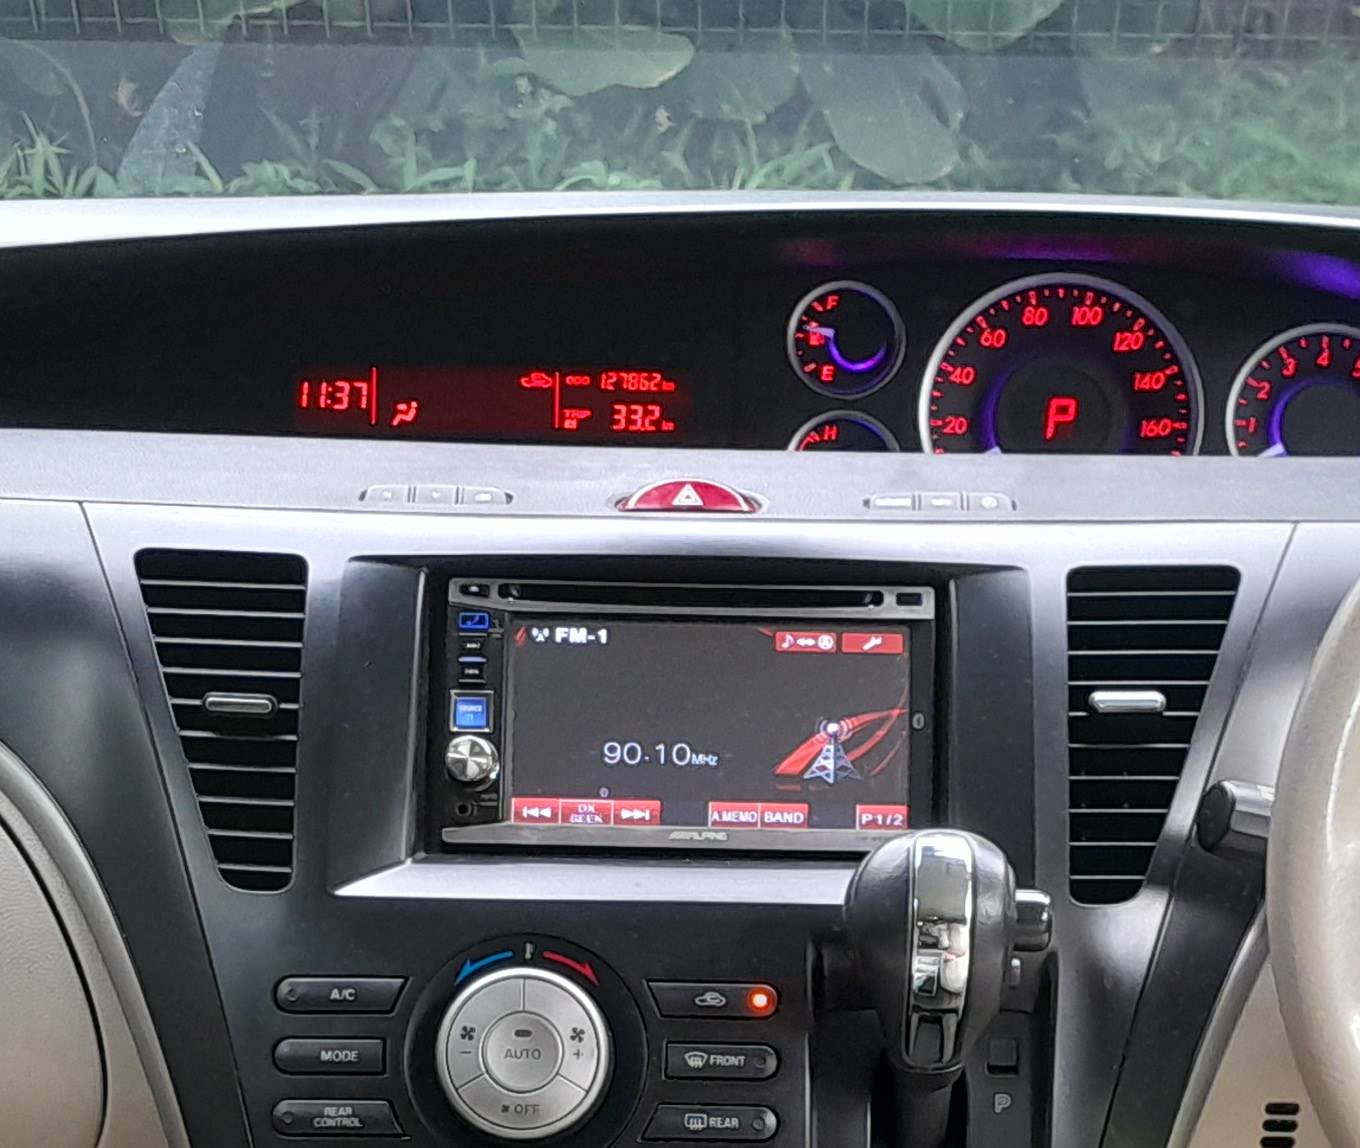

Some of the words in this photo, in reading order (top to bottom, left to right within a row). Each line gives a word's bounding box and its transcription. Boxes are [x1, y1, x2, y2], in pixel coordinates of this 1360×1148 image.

[827, 296, 839, 310] F
[1022, 307, 1048, 325] 80
[1072, 307, 1103, 325] 100
[981, 329, 1006, 347] 60
[1113, 332, 1144, 350] 120
[1317, 351, 1330, 366] 4
[821, 366, 834, 381] E
[950, 366, 975, 384] 40
[1282, 359, 1297, 377] 3
[601, 372, 662, 391] 127862
[1134, 372, 1166, 390] 140
[1257, 381, 1271, 399] 2
[300, 381, 369, 410] 11:37
[944, 417, 968, 435] 20
[1046, 398, 1079, 440] P
[1141, 418, 1172, 437] 160
[824, 425, 838, 440] H
[555, 627, 608, 644] FM-1
[603, 741, 690, 765] 90.10
[691, 753, 719, 766] MHz
[764, 811, 804, 824] BAND
[330, 988, 356, 1000] A/C
[320, 1050, 359, 1062] MODE
[504, 1047, 542, 1060] AUTO
[709, 1054, 746, 1067] FRONT
[323, 1106, 353, 1116] REAR
[513, 1104, 542, 1116] OFF
[994, 1093, 1012, 1113] P
[313, 1117, 363, 1127] CONTROL
[709, 1117, 740, 1129] REAR
